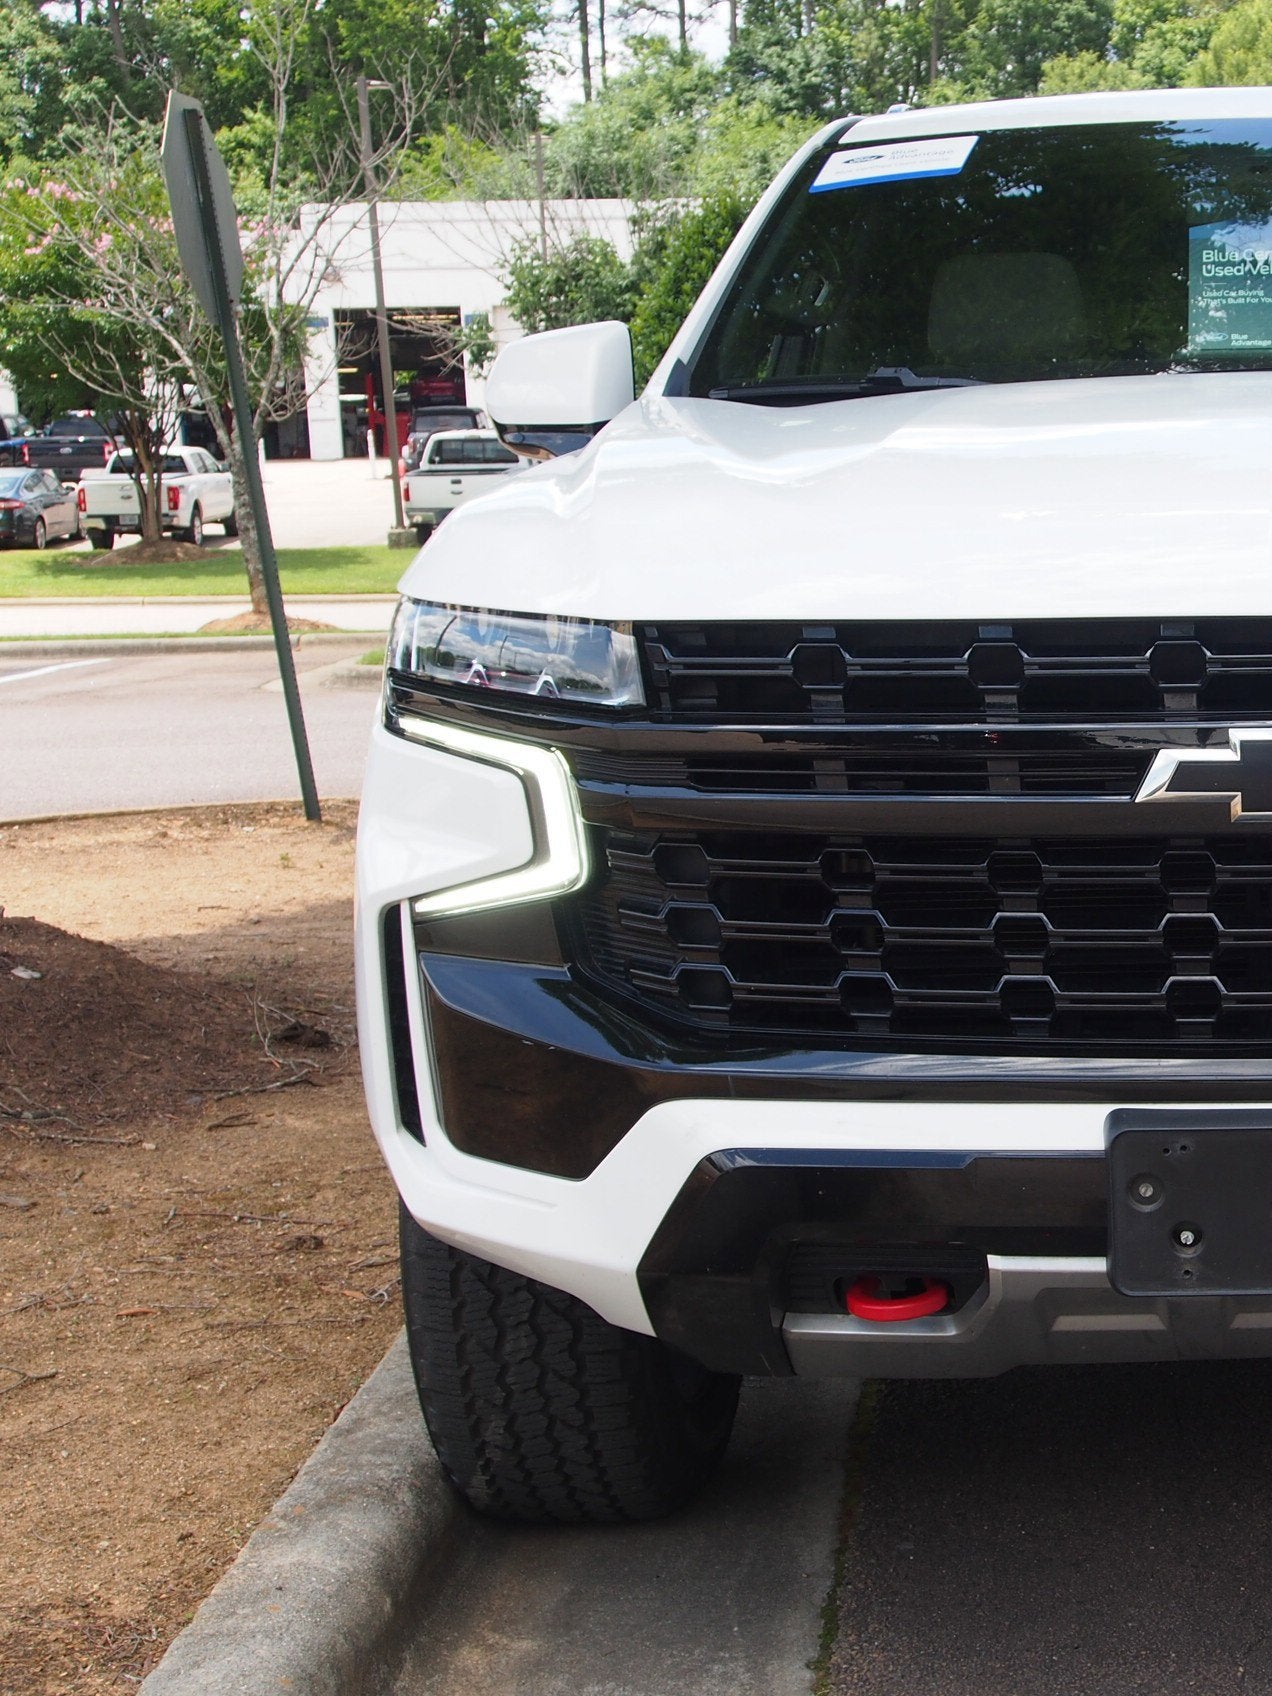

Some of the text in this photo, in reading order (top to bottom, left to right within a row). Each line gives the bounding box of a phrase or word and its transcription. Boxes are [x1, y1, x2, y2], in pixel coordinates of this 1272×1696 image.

[1202, 250, 1238, 262] Blue
[1202, 262, 1245, 277] Used
[1238, 289, 1264, 297] Buying
